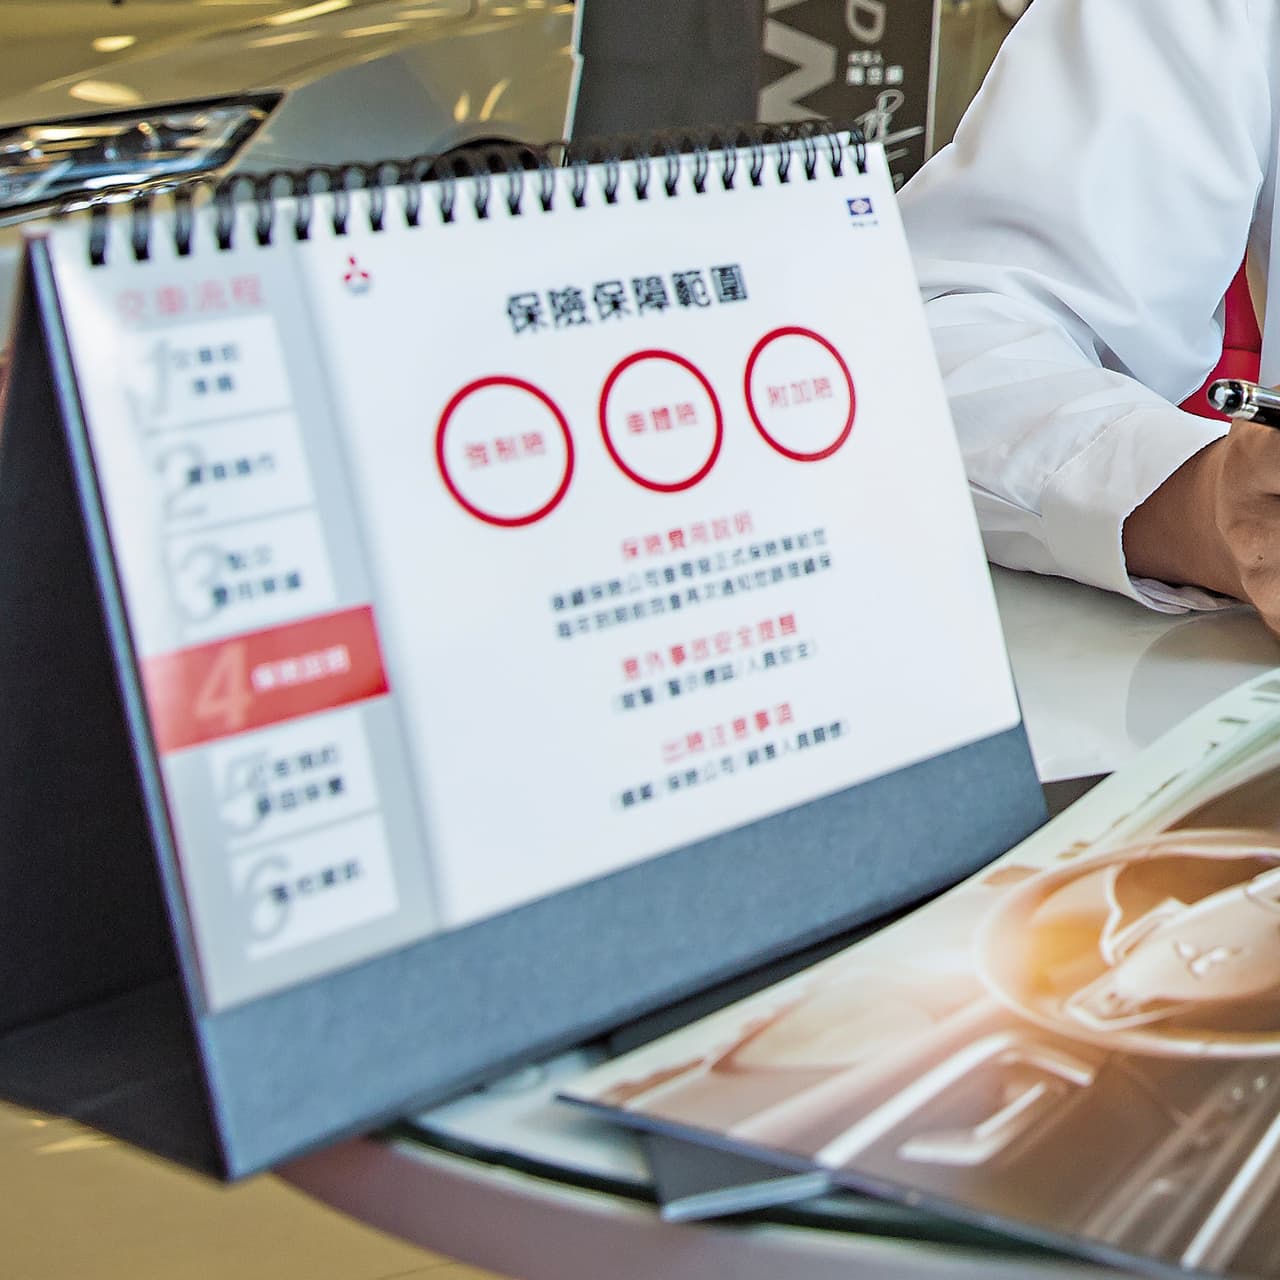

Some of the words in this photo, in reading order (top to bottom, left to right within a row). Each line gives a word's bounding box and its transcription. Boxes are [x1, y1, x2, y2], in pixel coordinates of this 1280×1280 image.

[506, 263, 747, 334] 保險保障範圍
